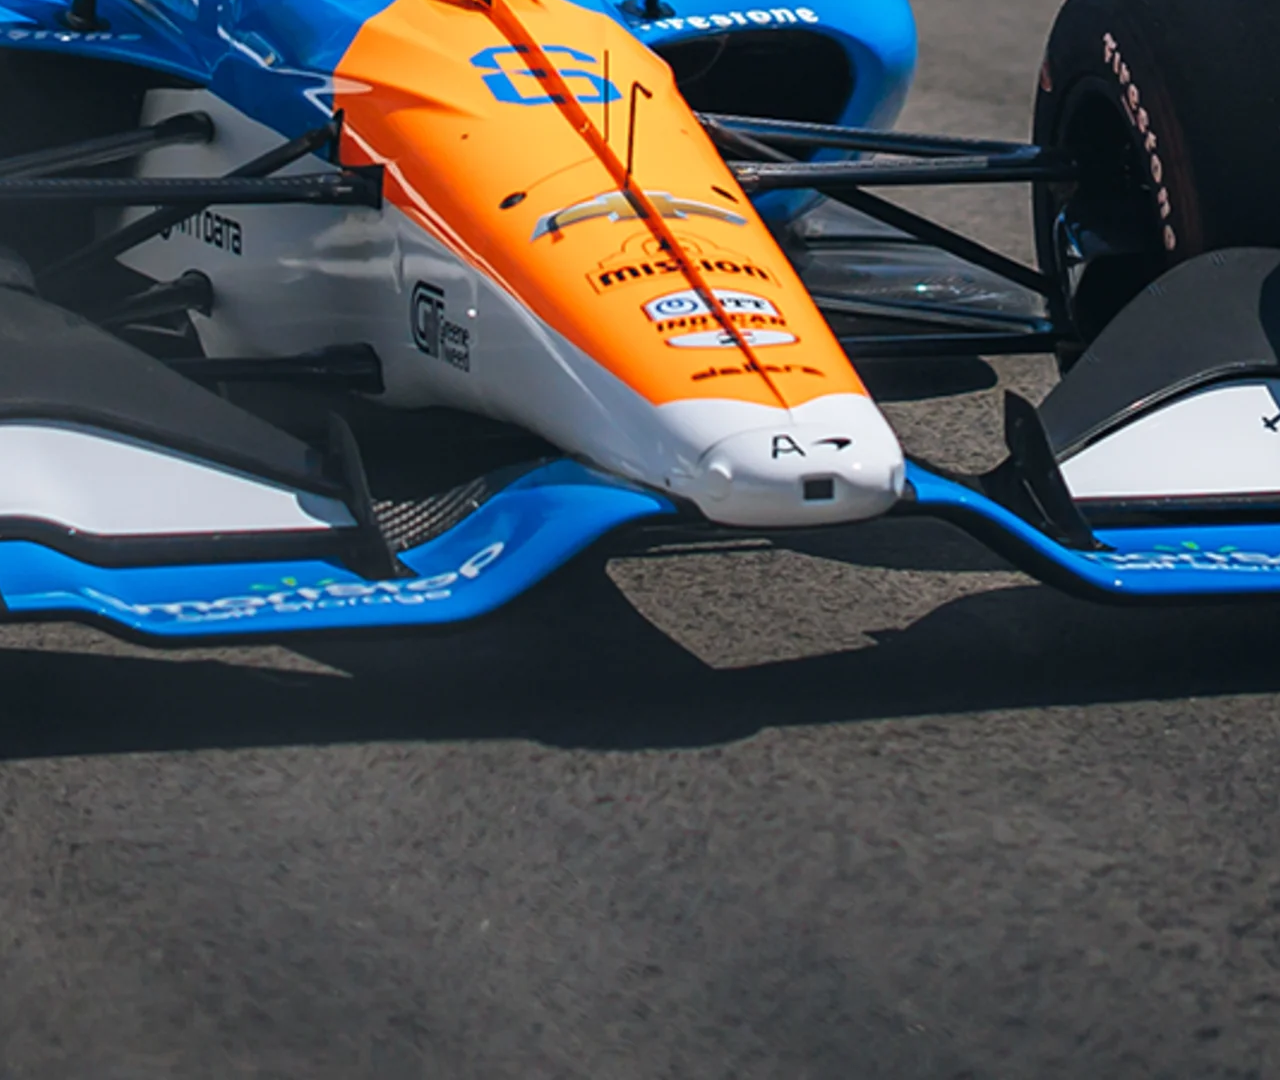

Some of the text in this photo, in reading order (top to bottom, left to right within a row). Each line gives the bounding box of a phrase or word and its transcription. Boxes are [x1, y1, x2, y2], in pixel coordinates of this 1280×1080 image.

[469, 44, 624, 107] 6
[718, 296, 766, 310] TT
[656, 313, 786, 332] INDCAR
